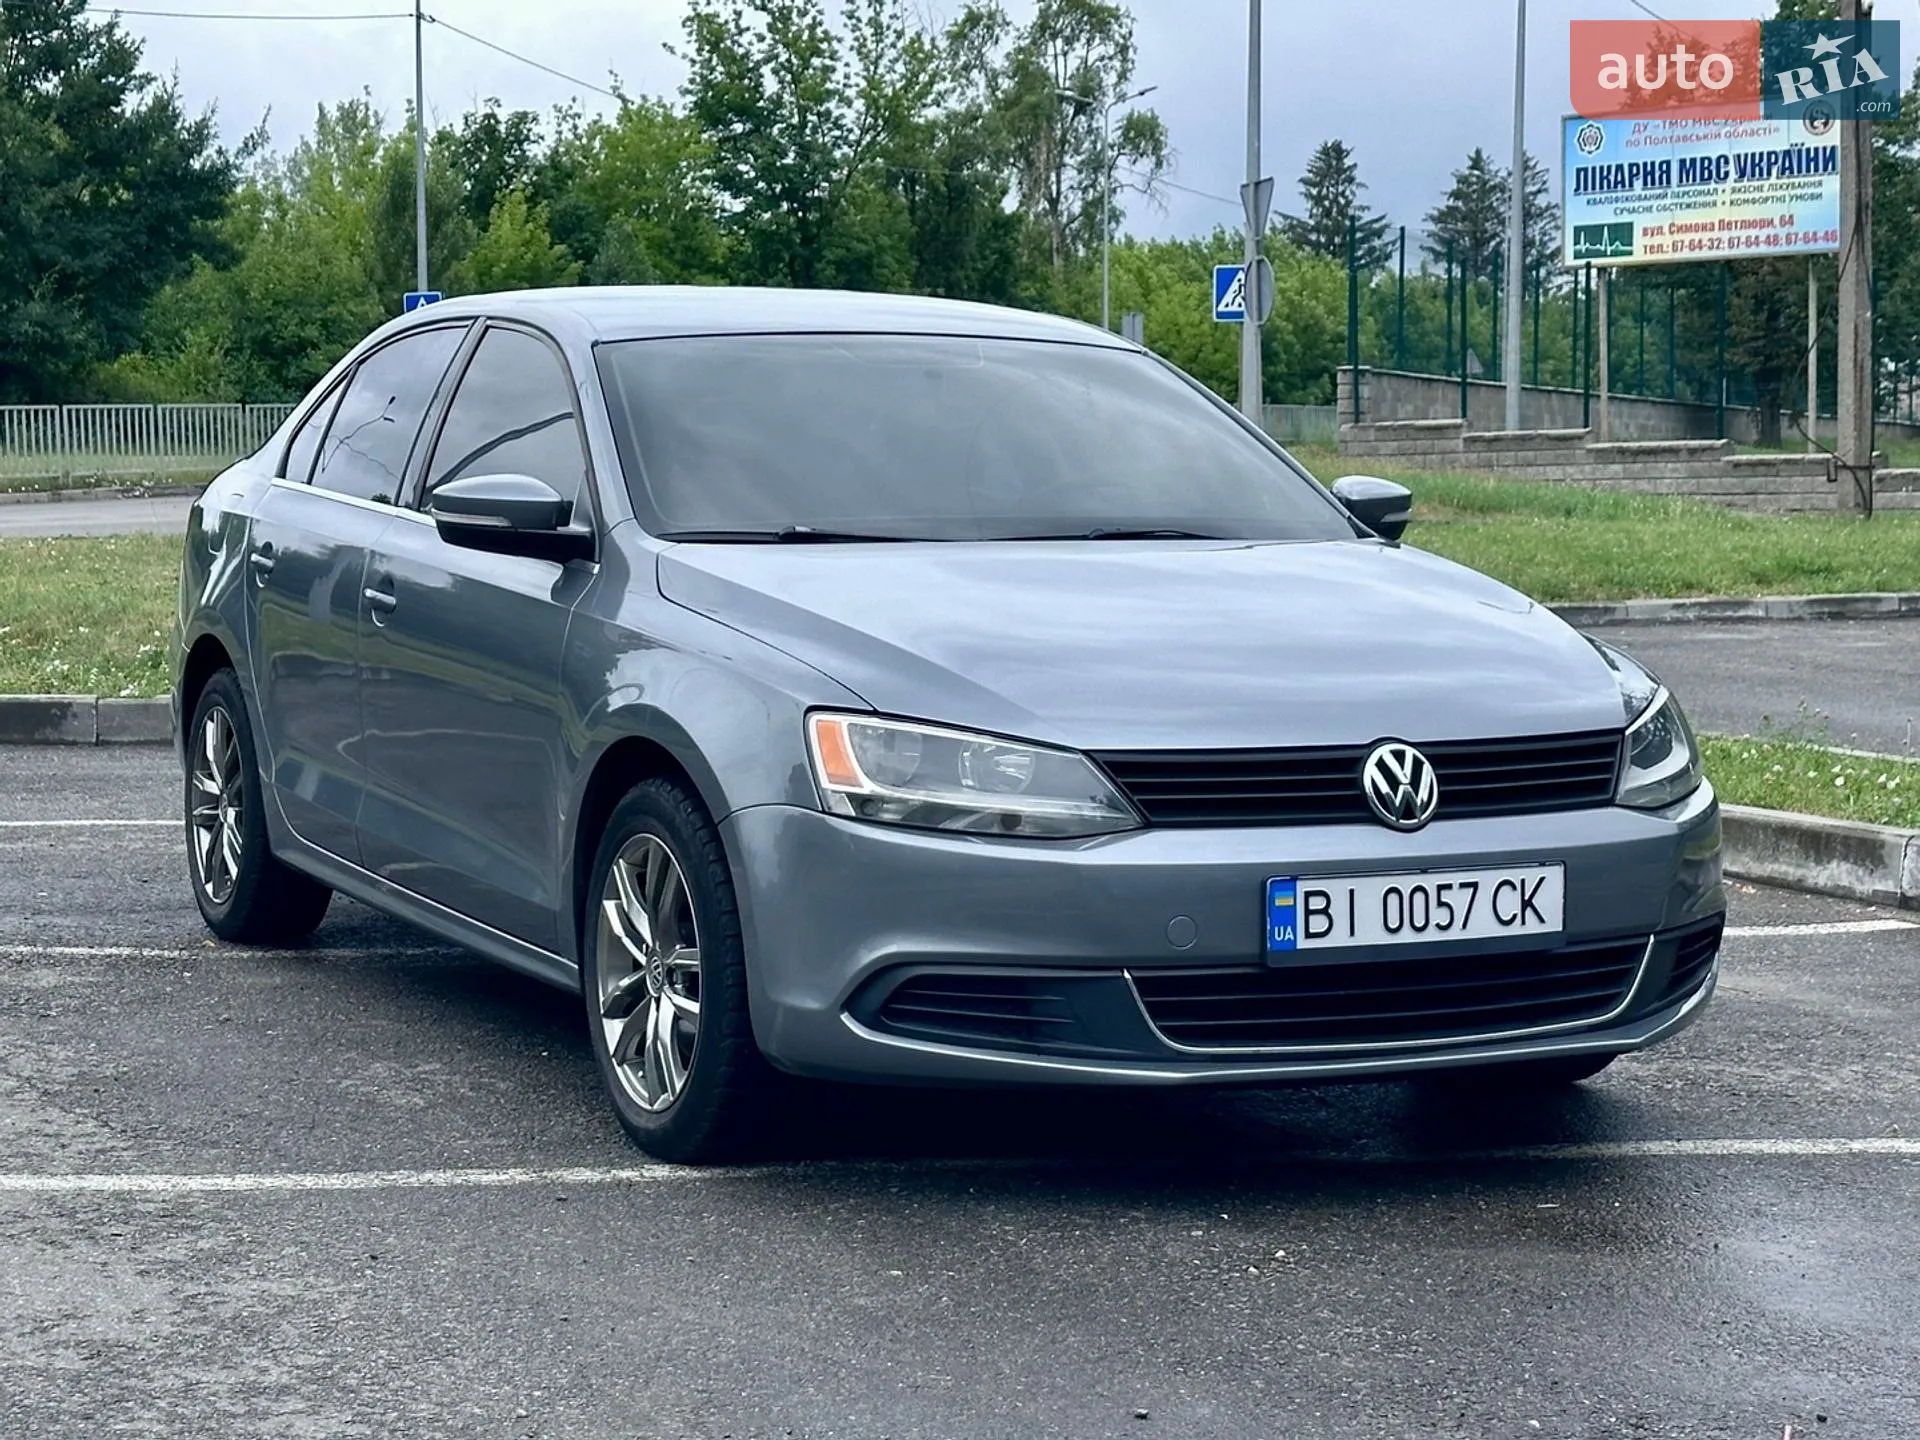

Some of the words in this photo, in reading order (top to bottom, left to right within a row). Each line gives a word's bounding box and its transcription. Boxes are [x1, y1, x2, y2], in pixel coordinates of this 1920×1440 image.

[1625, 139, 1641, 148] по
[1643, 130, 1721, 146] Полтавській
[1573, 160, 1672, 192] ЛІКАРНЯ
[1678, 154, 1731, 183] МВС
[1733, 142, 1838, 179] УКРАЇНИ
[1668, 221, 1715, 235] Симона
[1303, 887, 1356, 939] BI
[1381, 880, 1480, 934] 0057
[1491, 875, 1547, 926] CK
[1274, 926, 1295, 942] UA
